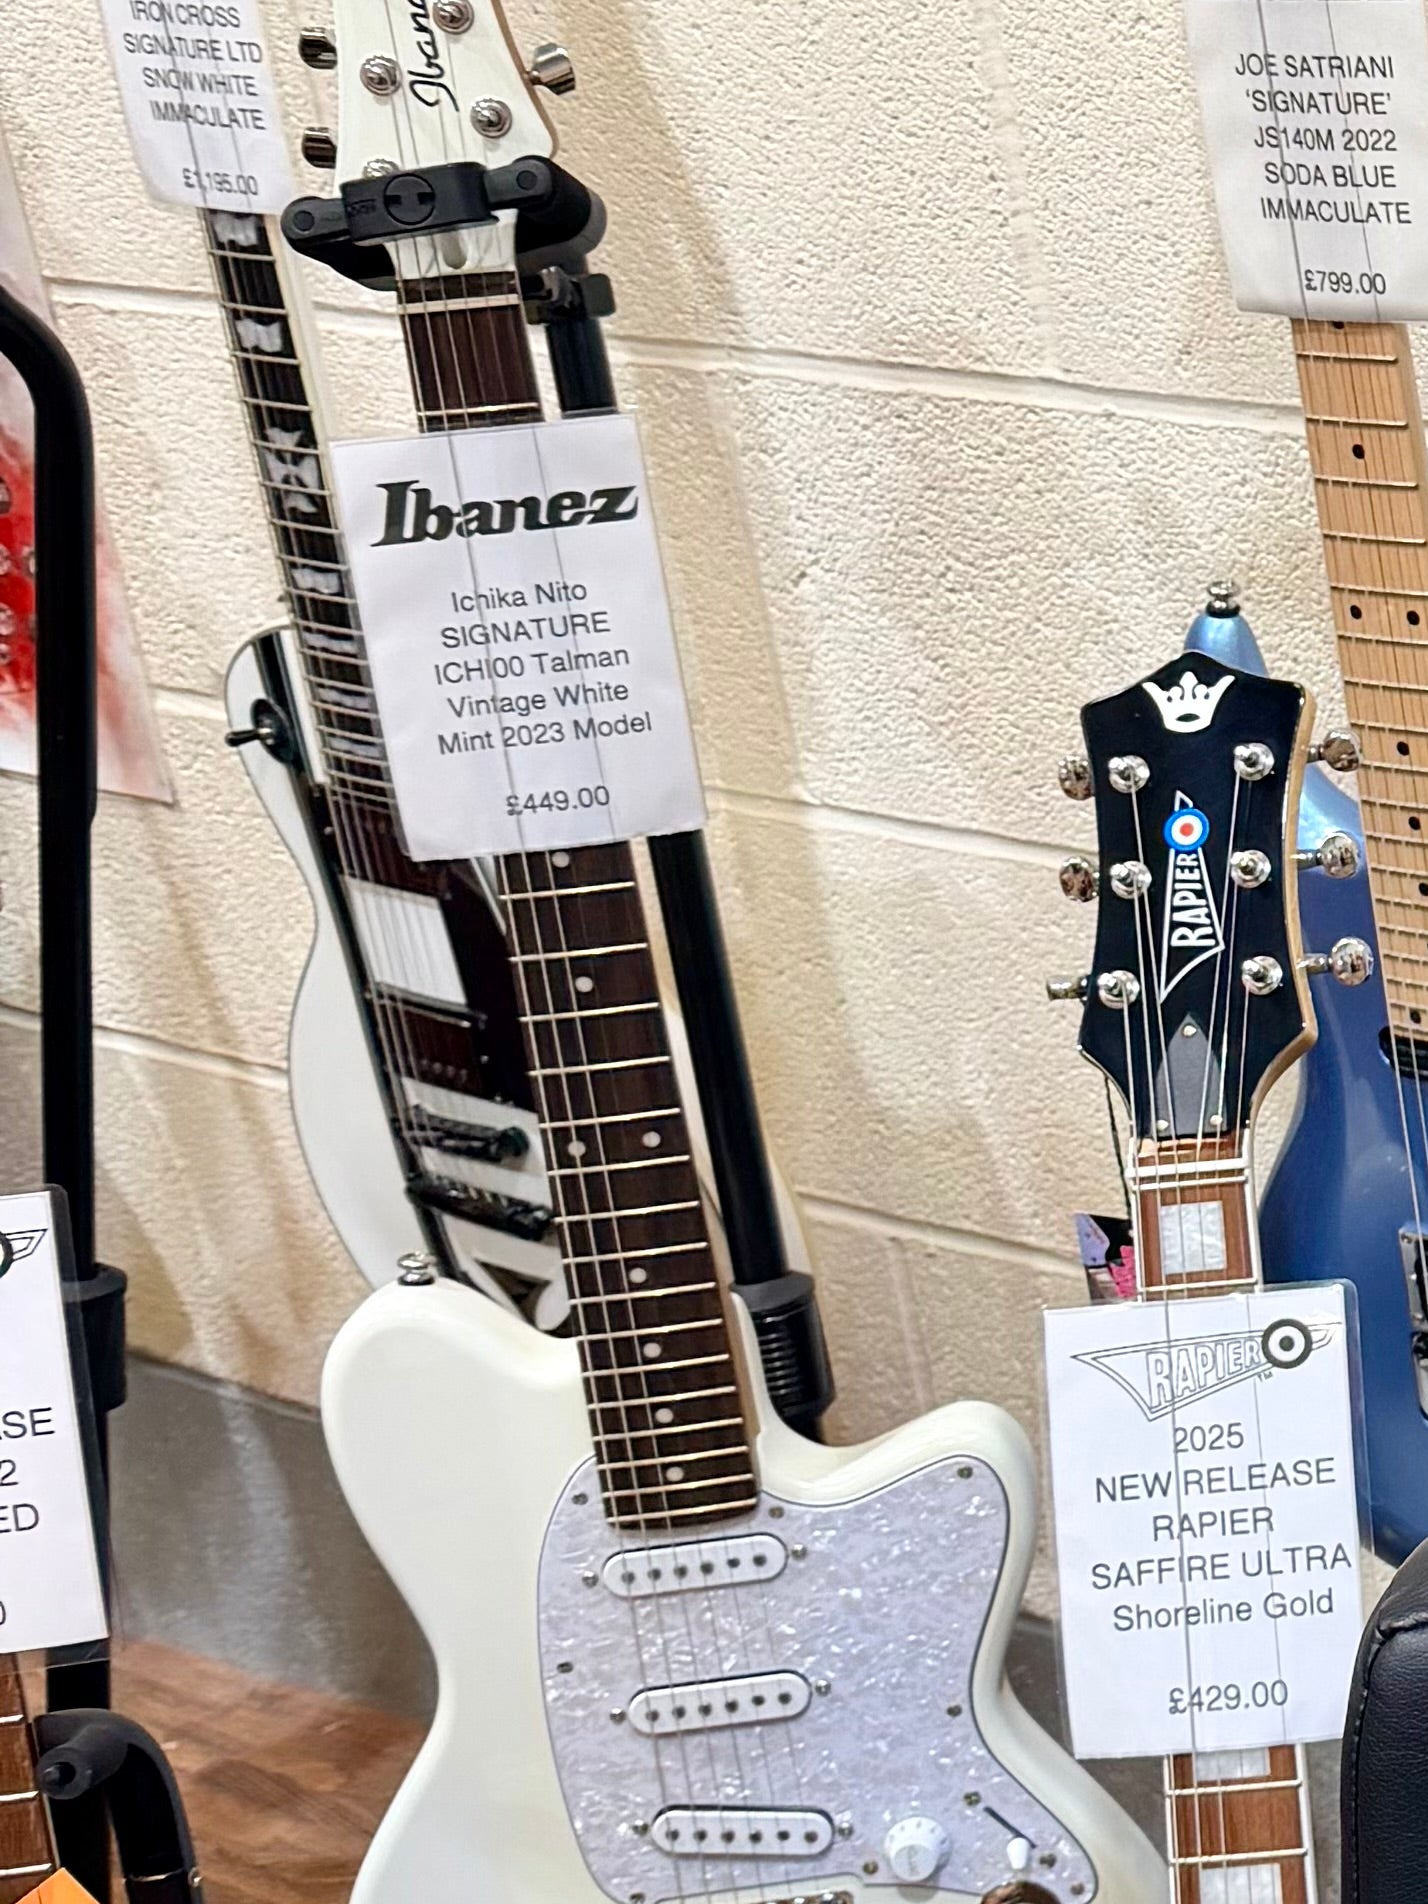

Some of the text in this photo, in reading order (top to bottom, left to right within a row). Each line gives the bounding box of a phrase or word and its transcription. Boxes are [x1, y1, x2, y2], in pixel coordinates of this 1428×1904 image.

[131, 0, 241, 28] IRON CROSS
[123, 33, 263, 63] SIGNATURE LTD
[143, 67, 258, 96] SNOW WHITE
[1235, 54, 1394, 78] JOE SATRIANI
[150, 100, 266, 130] IMMACULATE
[1254, 126, 1397, 152] JS140M 2022
[1264, 163, 1396, 188] SODA BLUE
[1261, 197, 1412, 225] IMMACULATE
[1305, 270, 1386, 295] £799.00
[370, 479, 638, 547] Ibanez
[451, 582, 587, 613] Ichika Nito
[441, 612, 611, 648] SIGNATURE
[531, 648, 629, 678] Talman
[447, 683, 629, 718] Vintage White
[439, 712, 652, 755] Mint 2023 Model
[506, 785, 610, 816] £449.00
[1170, 853, 1216, 947] RAPIER
[1145, 1336, 1264, 1409] RAPIER
[0, 1407, 55, 1439] SE
[1174, 1423, 1244, 1453] 2025
[1095, 1457, 1336, 1503] NEW RELEASE
[1153, 1507, 1275, 1542] RAPIER
[1091, 1543, 1352, 1590] SAFFIRE ULTRA
[1113, 1588, 1334, 1632] Shoreline Gold
[1169, 1679, 1288, 1715] £429.00
